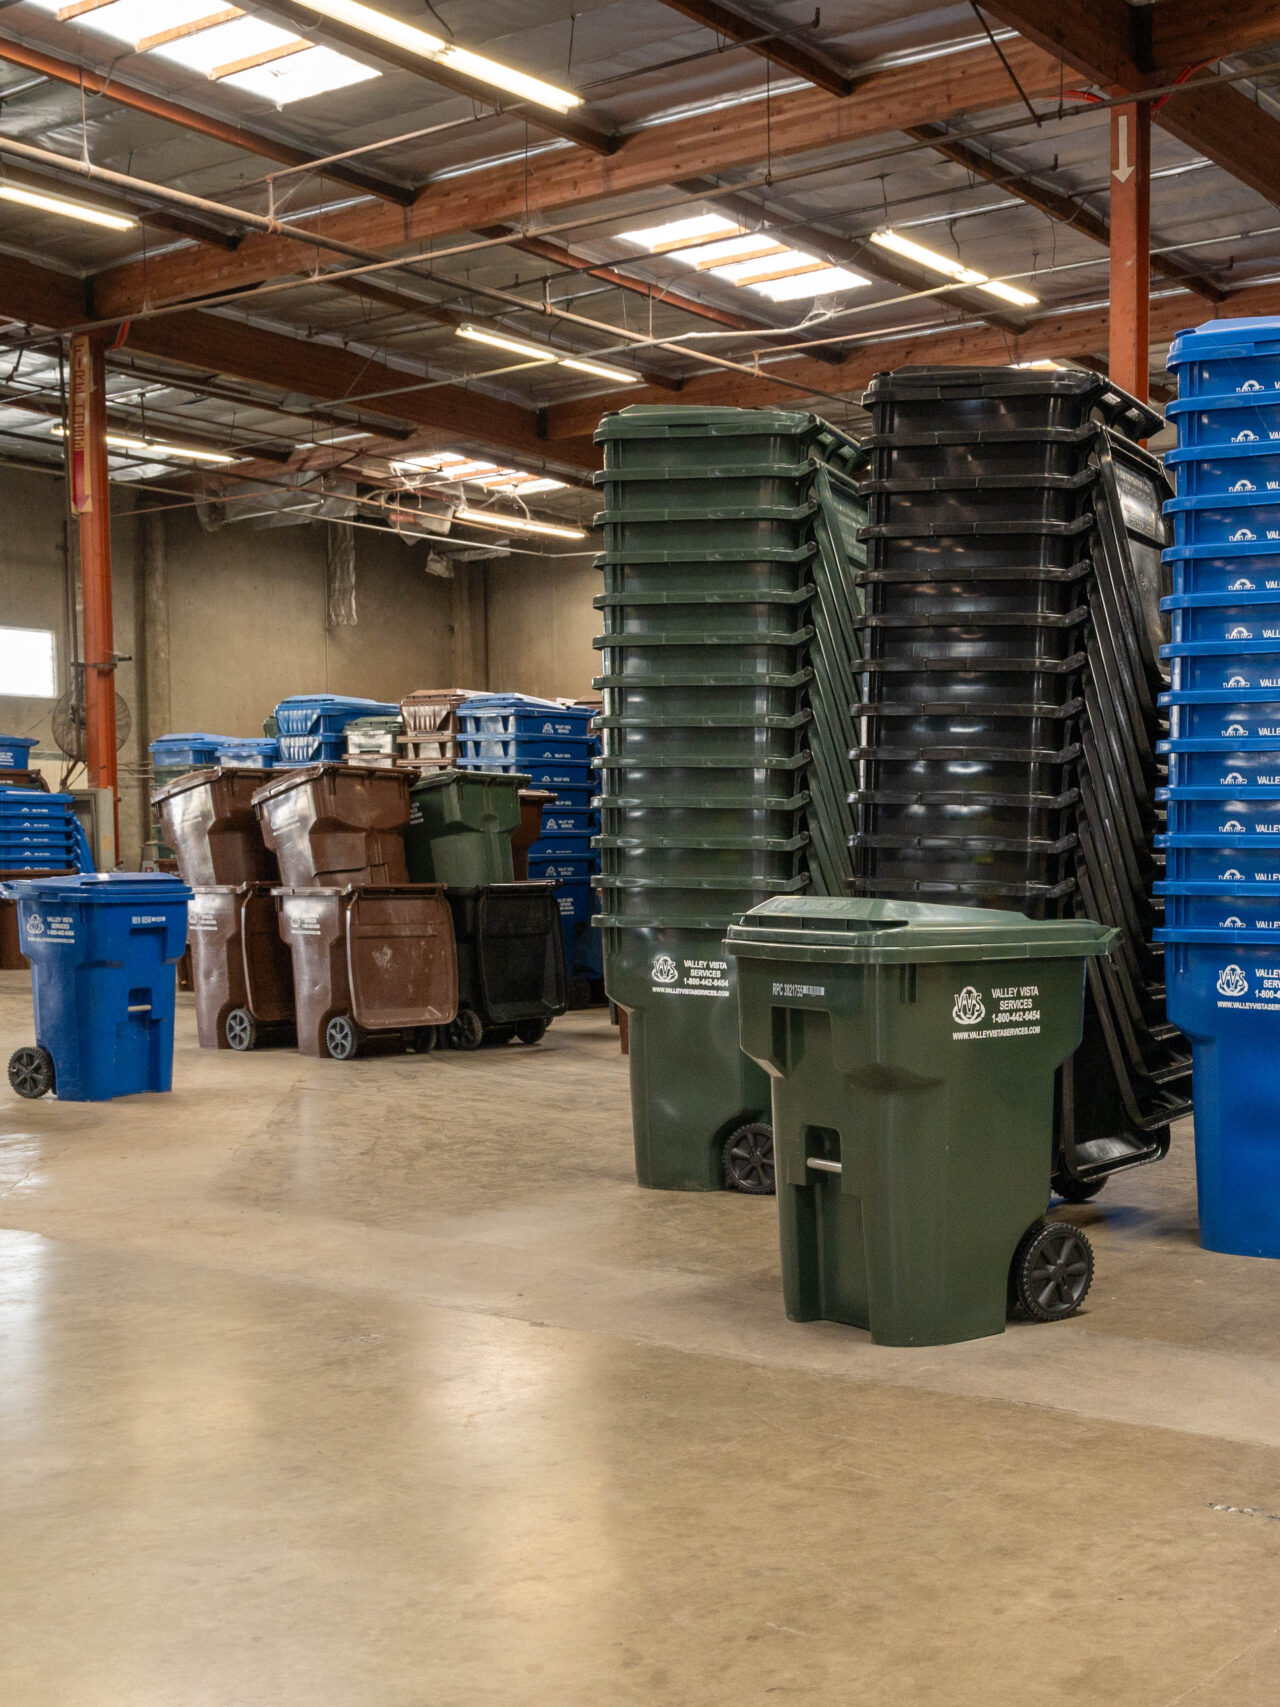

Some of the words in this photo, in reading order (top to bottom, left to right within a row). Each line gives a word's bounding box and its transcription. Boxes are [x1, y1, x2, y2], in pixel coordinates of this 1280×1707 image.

[74, 344, 85, 394] FIRE
[684, 960, 708, 968] VALLEY
[709, 961, 728, 970] VISTA
[690, 969, 721, 978] SERVICES
[772, 982, 783, 996] RPC
[992, 987, 1018, 998] VALLEY
[1020, 986, 1040, 996] VISTA
[1000, 999, 1032, 1010] SERVICES
[992, 1010, 1040, 1023] 1-800-442-6454
[952, 1026, 1040, 1040] WWW.VALLEYVISTASERVICES.COM
